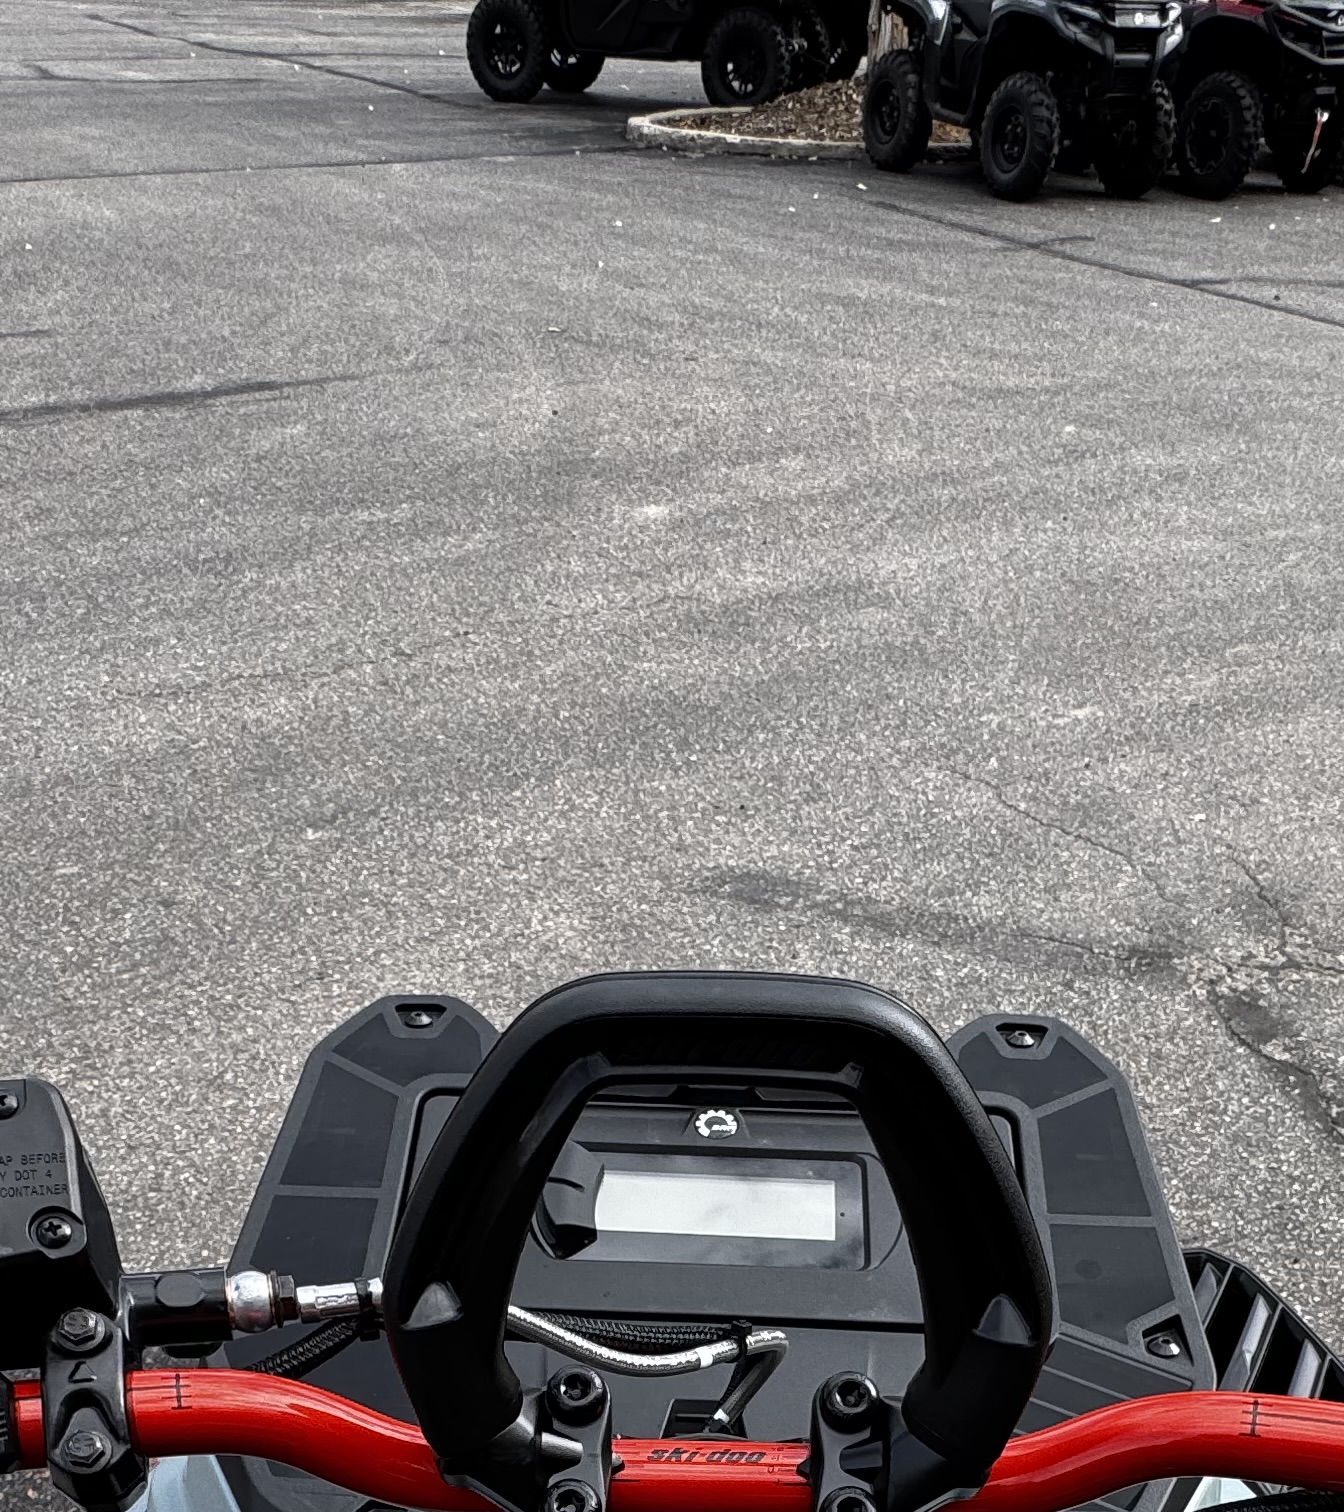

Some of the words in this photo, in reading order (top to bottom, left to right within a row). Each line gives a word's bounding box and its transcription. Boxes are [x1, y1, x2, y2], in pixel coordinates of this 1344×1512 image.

[21, 1152, 66, 1166] BEFORE
[15, 1170, 37, 1181] DOT
[45, 1170, 53, 1179] 4
[0, 1182, 69, 1199] CONTAINER
[647, 1447, 767, 1464] ski-doo
